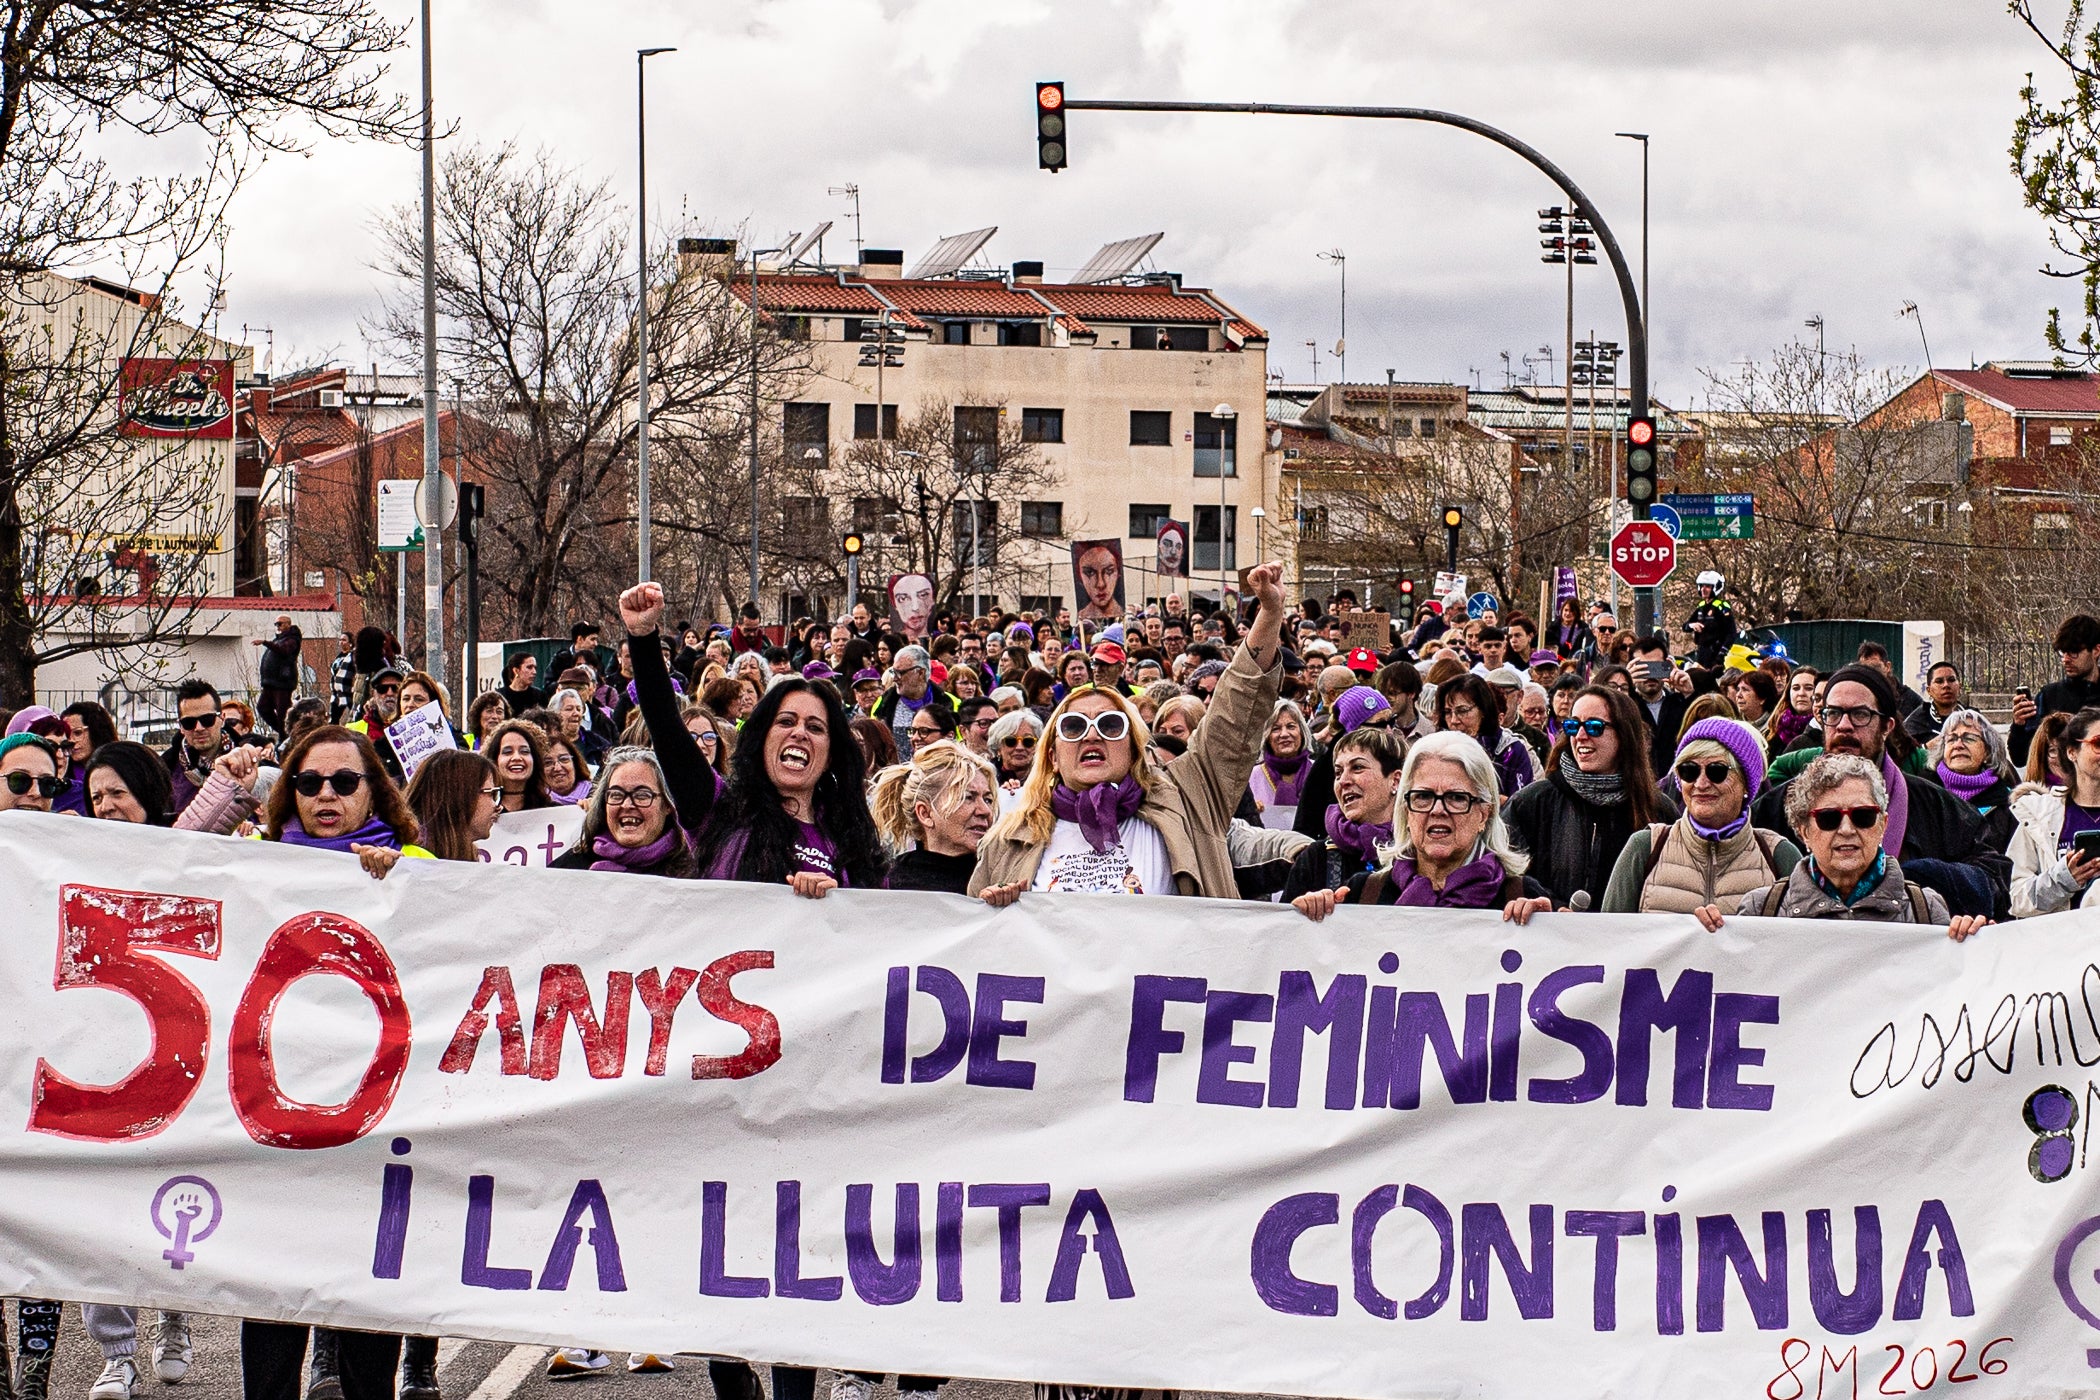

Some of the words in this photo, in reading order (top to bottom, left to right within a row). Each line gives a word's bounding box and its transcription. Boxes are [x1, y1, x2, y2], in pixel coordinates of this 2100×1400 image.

[1675, 495, 1715, 504] Barcelona
[1676, 507, 1709, 516] Manresa
[1616, 547, 1670, 562] STOP
[1353, 622, 1378, 630] NUNCA
[1349, 635, 1379, 648] GUAPA
[1064, 870, 1095, 878] MEJOR
[28, 884, 411, 1149] 50
[440, 951, 781, 1081] ANYS
[881, 966, 1045, 1089] DE
[462, 1176, 626, 1292] LA
[700, 1181, 1134, 1305] LLUITA
[1767, 1338, 1857, 1400] 8M
[1879, 1338, 2013, 1394] 2026
